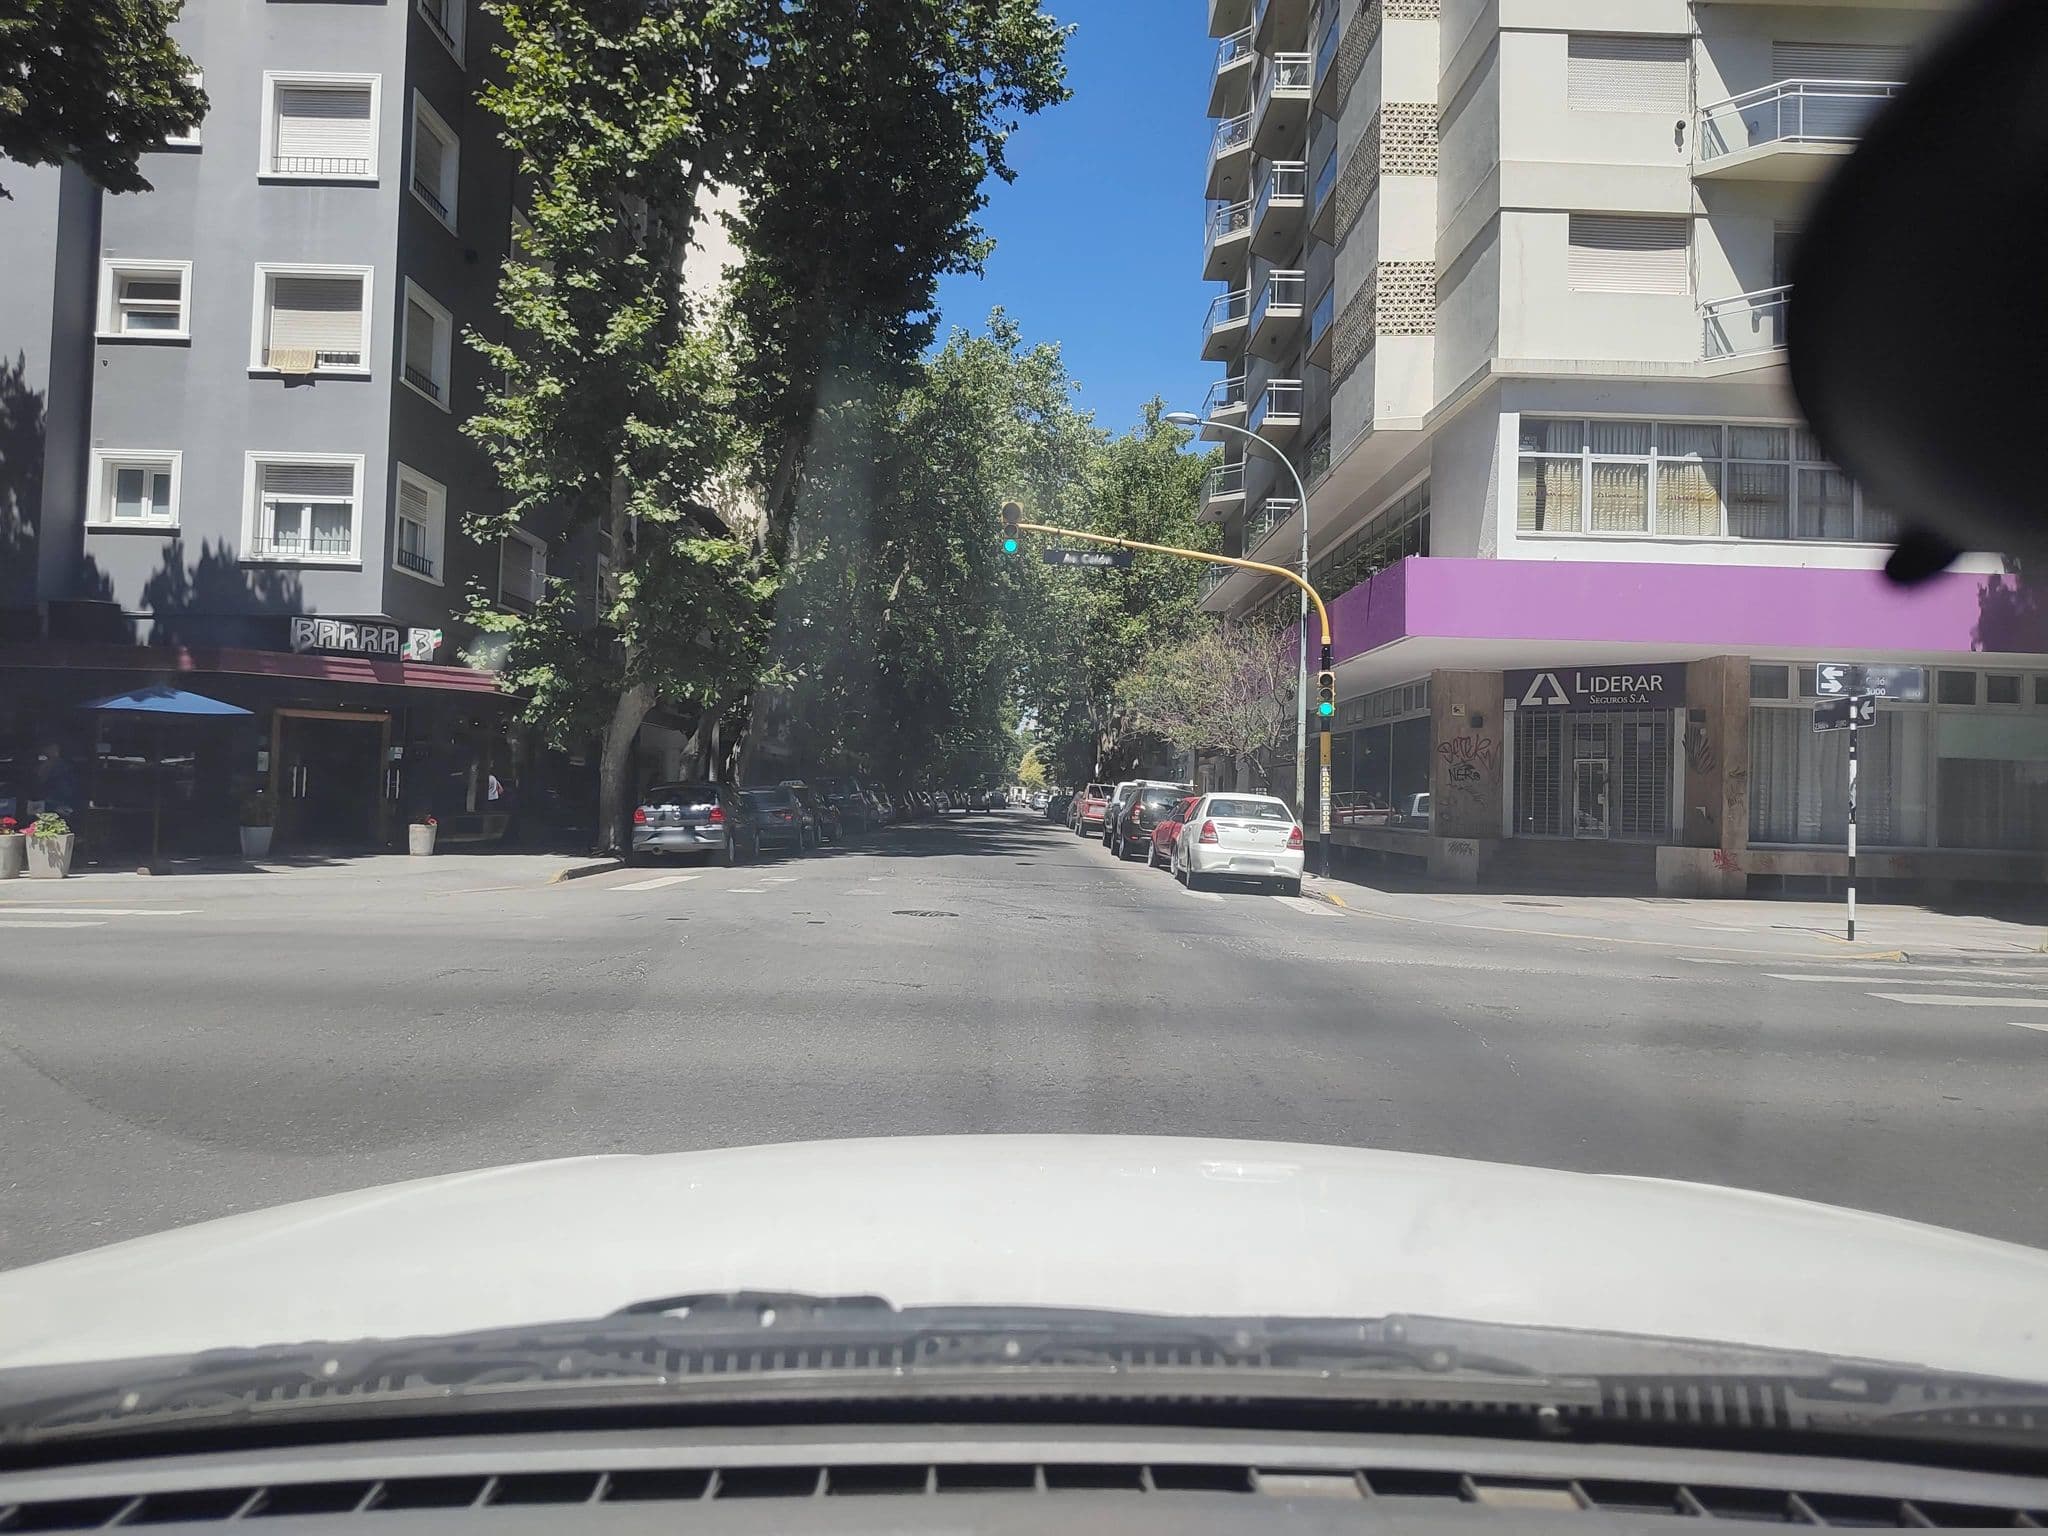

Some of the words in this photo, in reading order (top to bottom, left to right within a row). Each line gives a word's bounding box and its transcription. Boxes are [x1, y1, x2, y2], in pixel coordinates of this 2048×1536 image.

[290, 616, 399, 655] BARRA
[1576, 672, 1663, 693] LIDERAR
[1589, 694, 1628, 704] SEGUROS
[1629, 693, 1649, 704] S.A.
[1865, 687, 1886, 696] 3000
